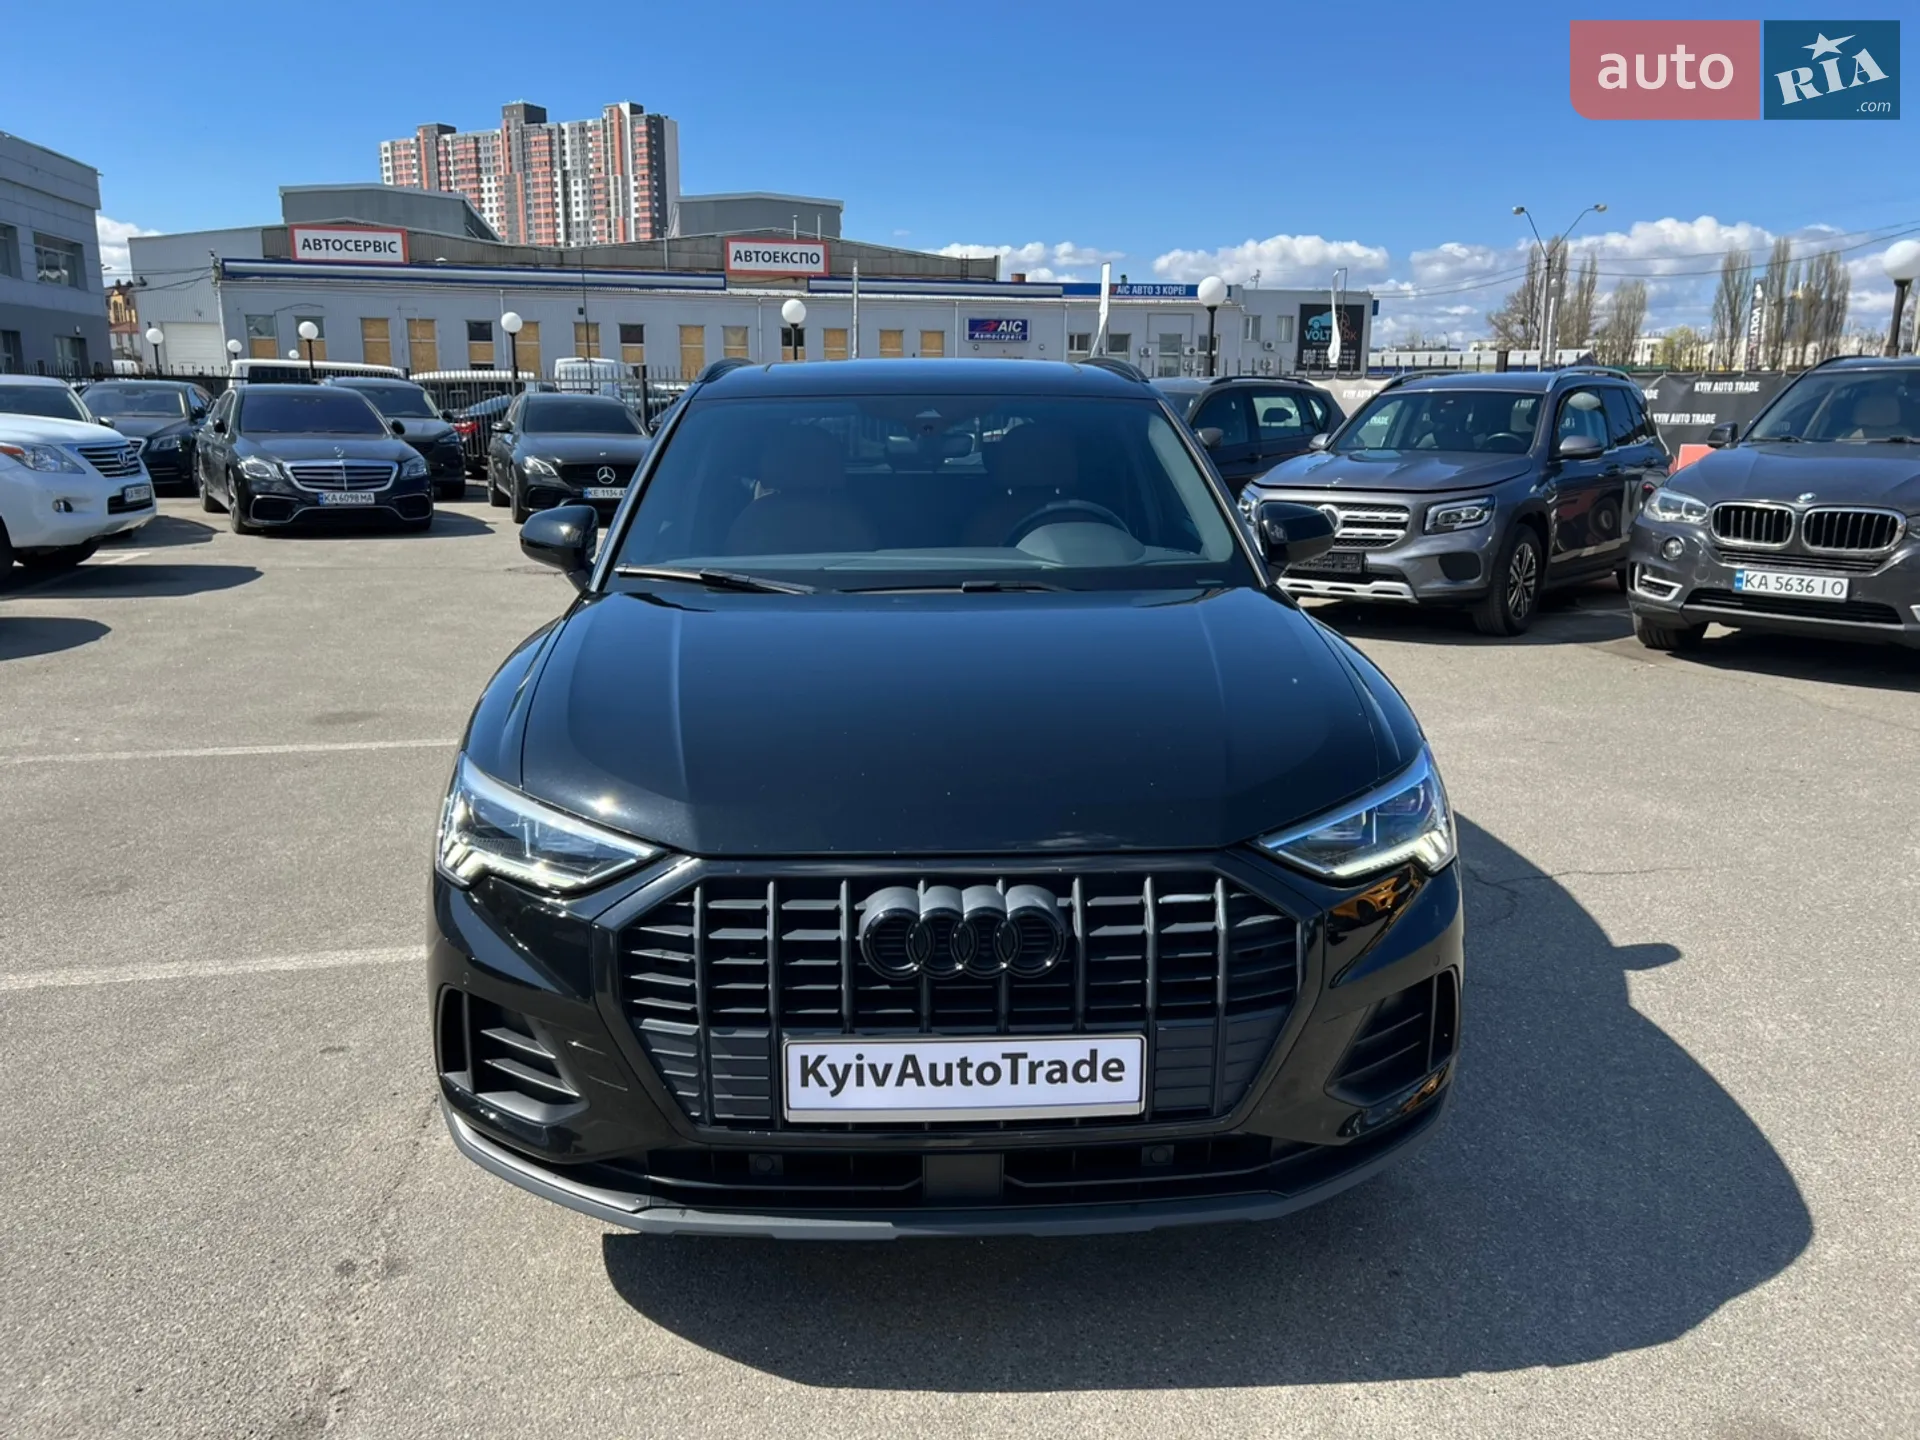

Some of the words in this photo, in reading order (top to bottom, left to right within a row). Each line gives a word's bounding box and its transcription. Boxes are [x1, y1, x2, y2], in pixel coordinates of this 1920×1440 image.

[301, 238, 398, 253] АВТОСЕРВІС
[733, 250, 821, 265] АВТОЕКСПО
[1131, 285, 1154, 296] АВТО
[1694, 381, 1713, 392] KYIV
[1713, 381, 1734, 392] AUTO
[1735, 381, 1760, 392] TRADE
[1670, 413, 1691, 423] AUTO
[1691, 413, 1716, 424] TRADE
[1744, 574, 1768, 590] KA
[1773, 576, 1815, 594] 5636
[799, 1048, 1125, 1097] KyivAutoTrade
